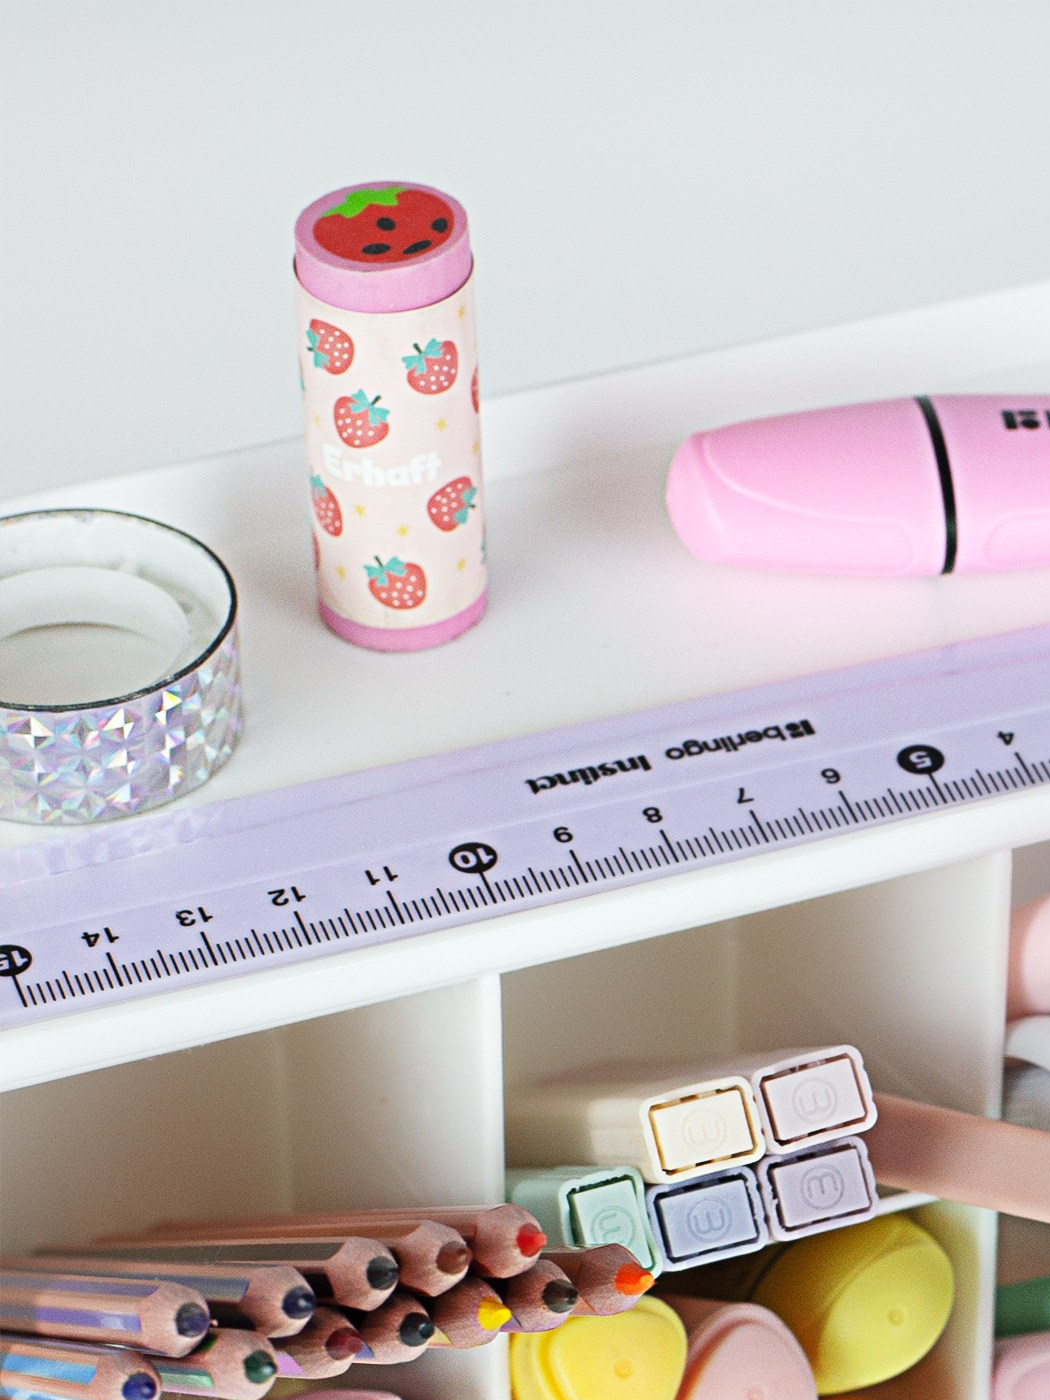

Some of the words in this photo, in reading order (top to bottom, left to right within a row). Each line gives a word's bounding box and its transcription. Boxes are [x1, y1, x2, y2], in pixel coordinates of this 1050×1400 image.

[665, 725, 787, 760] berlingo
[997, 731, 1015, 746] 4
[525, 755, 652, 794] Instinct
[820, 767, 842, 784] 6
[736, 787, 754, 804] 7
[641, 806, 664, 823] 8
[552, 826, 574, 843] 9
[364, 865, 398, 886] 11
[267, 886, 306, 907] 12
[175, 906, 213, 927] 13
[81, 927, 119, 948] 14
